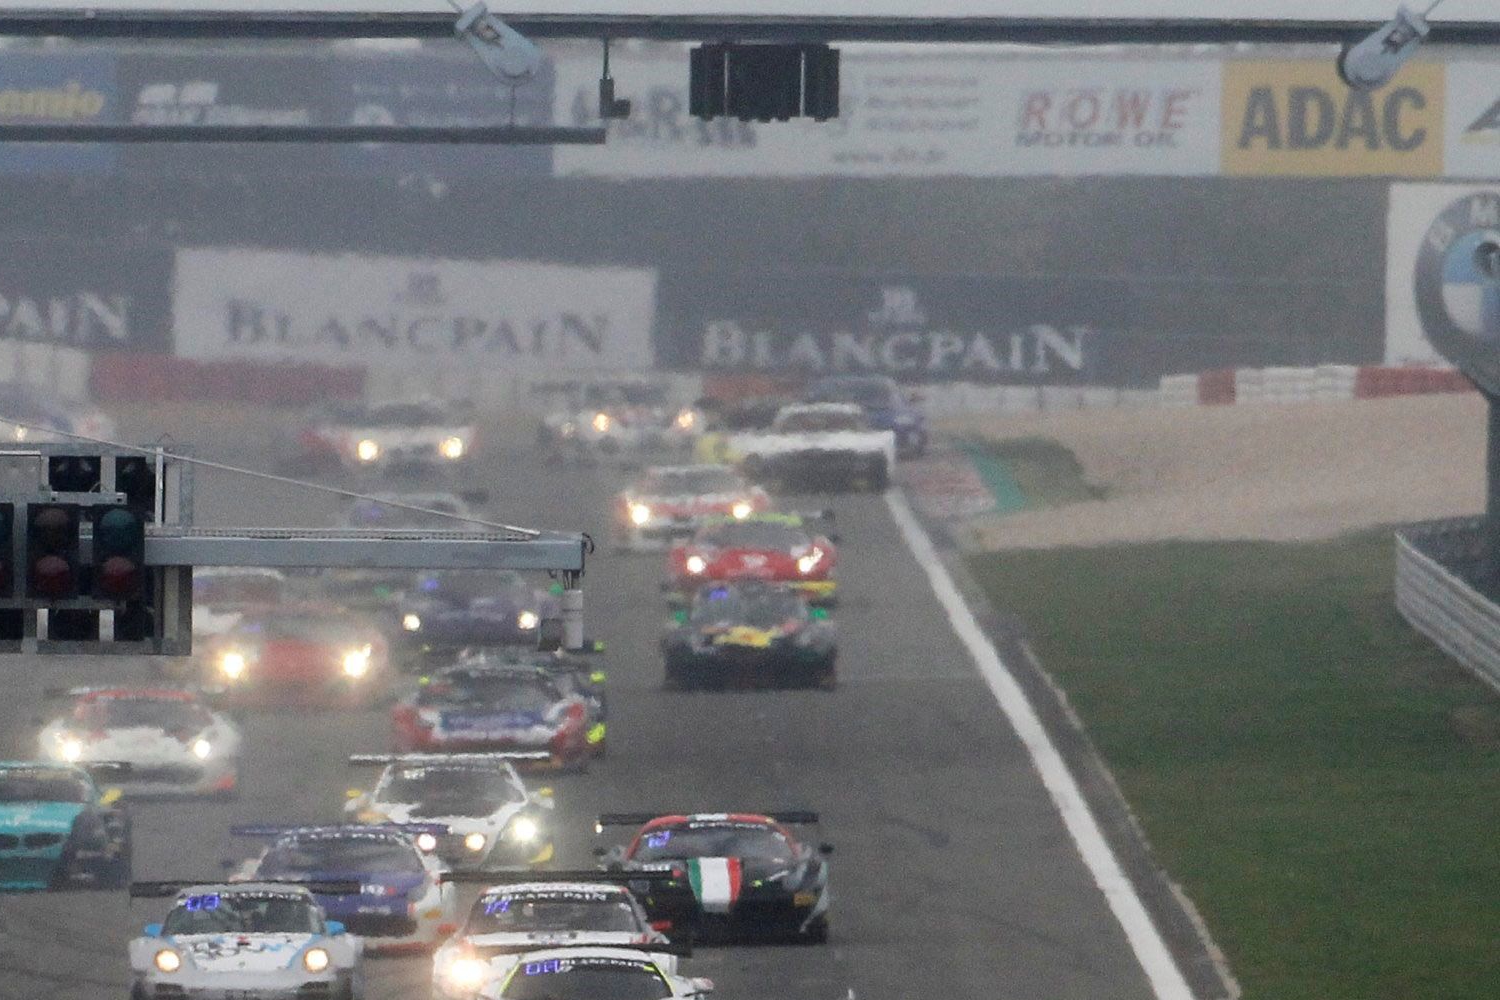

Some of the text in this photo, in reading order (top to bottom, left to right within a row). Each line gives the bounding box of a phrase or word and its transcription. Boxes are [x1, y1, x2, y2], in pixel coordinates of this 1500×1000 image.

[1018, 87, 1192, 131] ROWE
[1238, 85, 1428, 152] ADAC
[224, 301, 608, 354] BLANCPAIN
[703, 320, 1090, 372] BLANCPAIN
